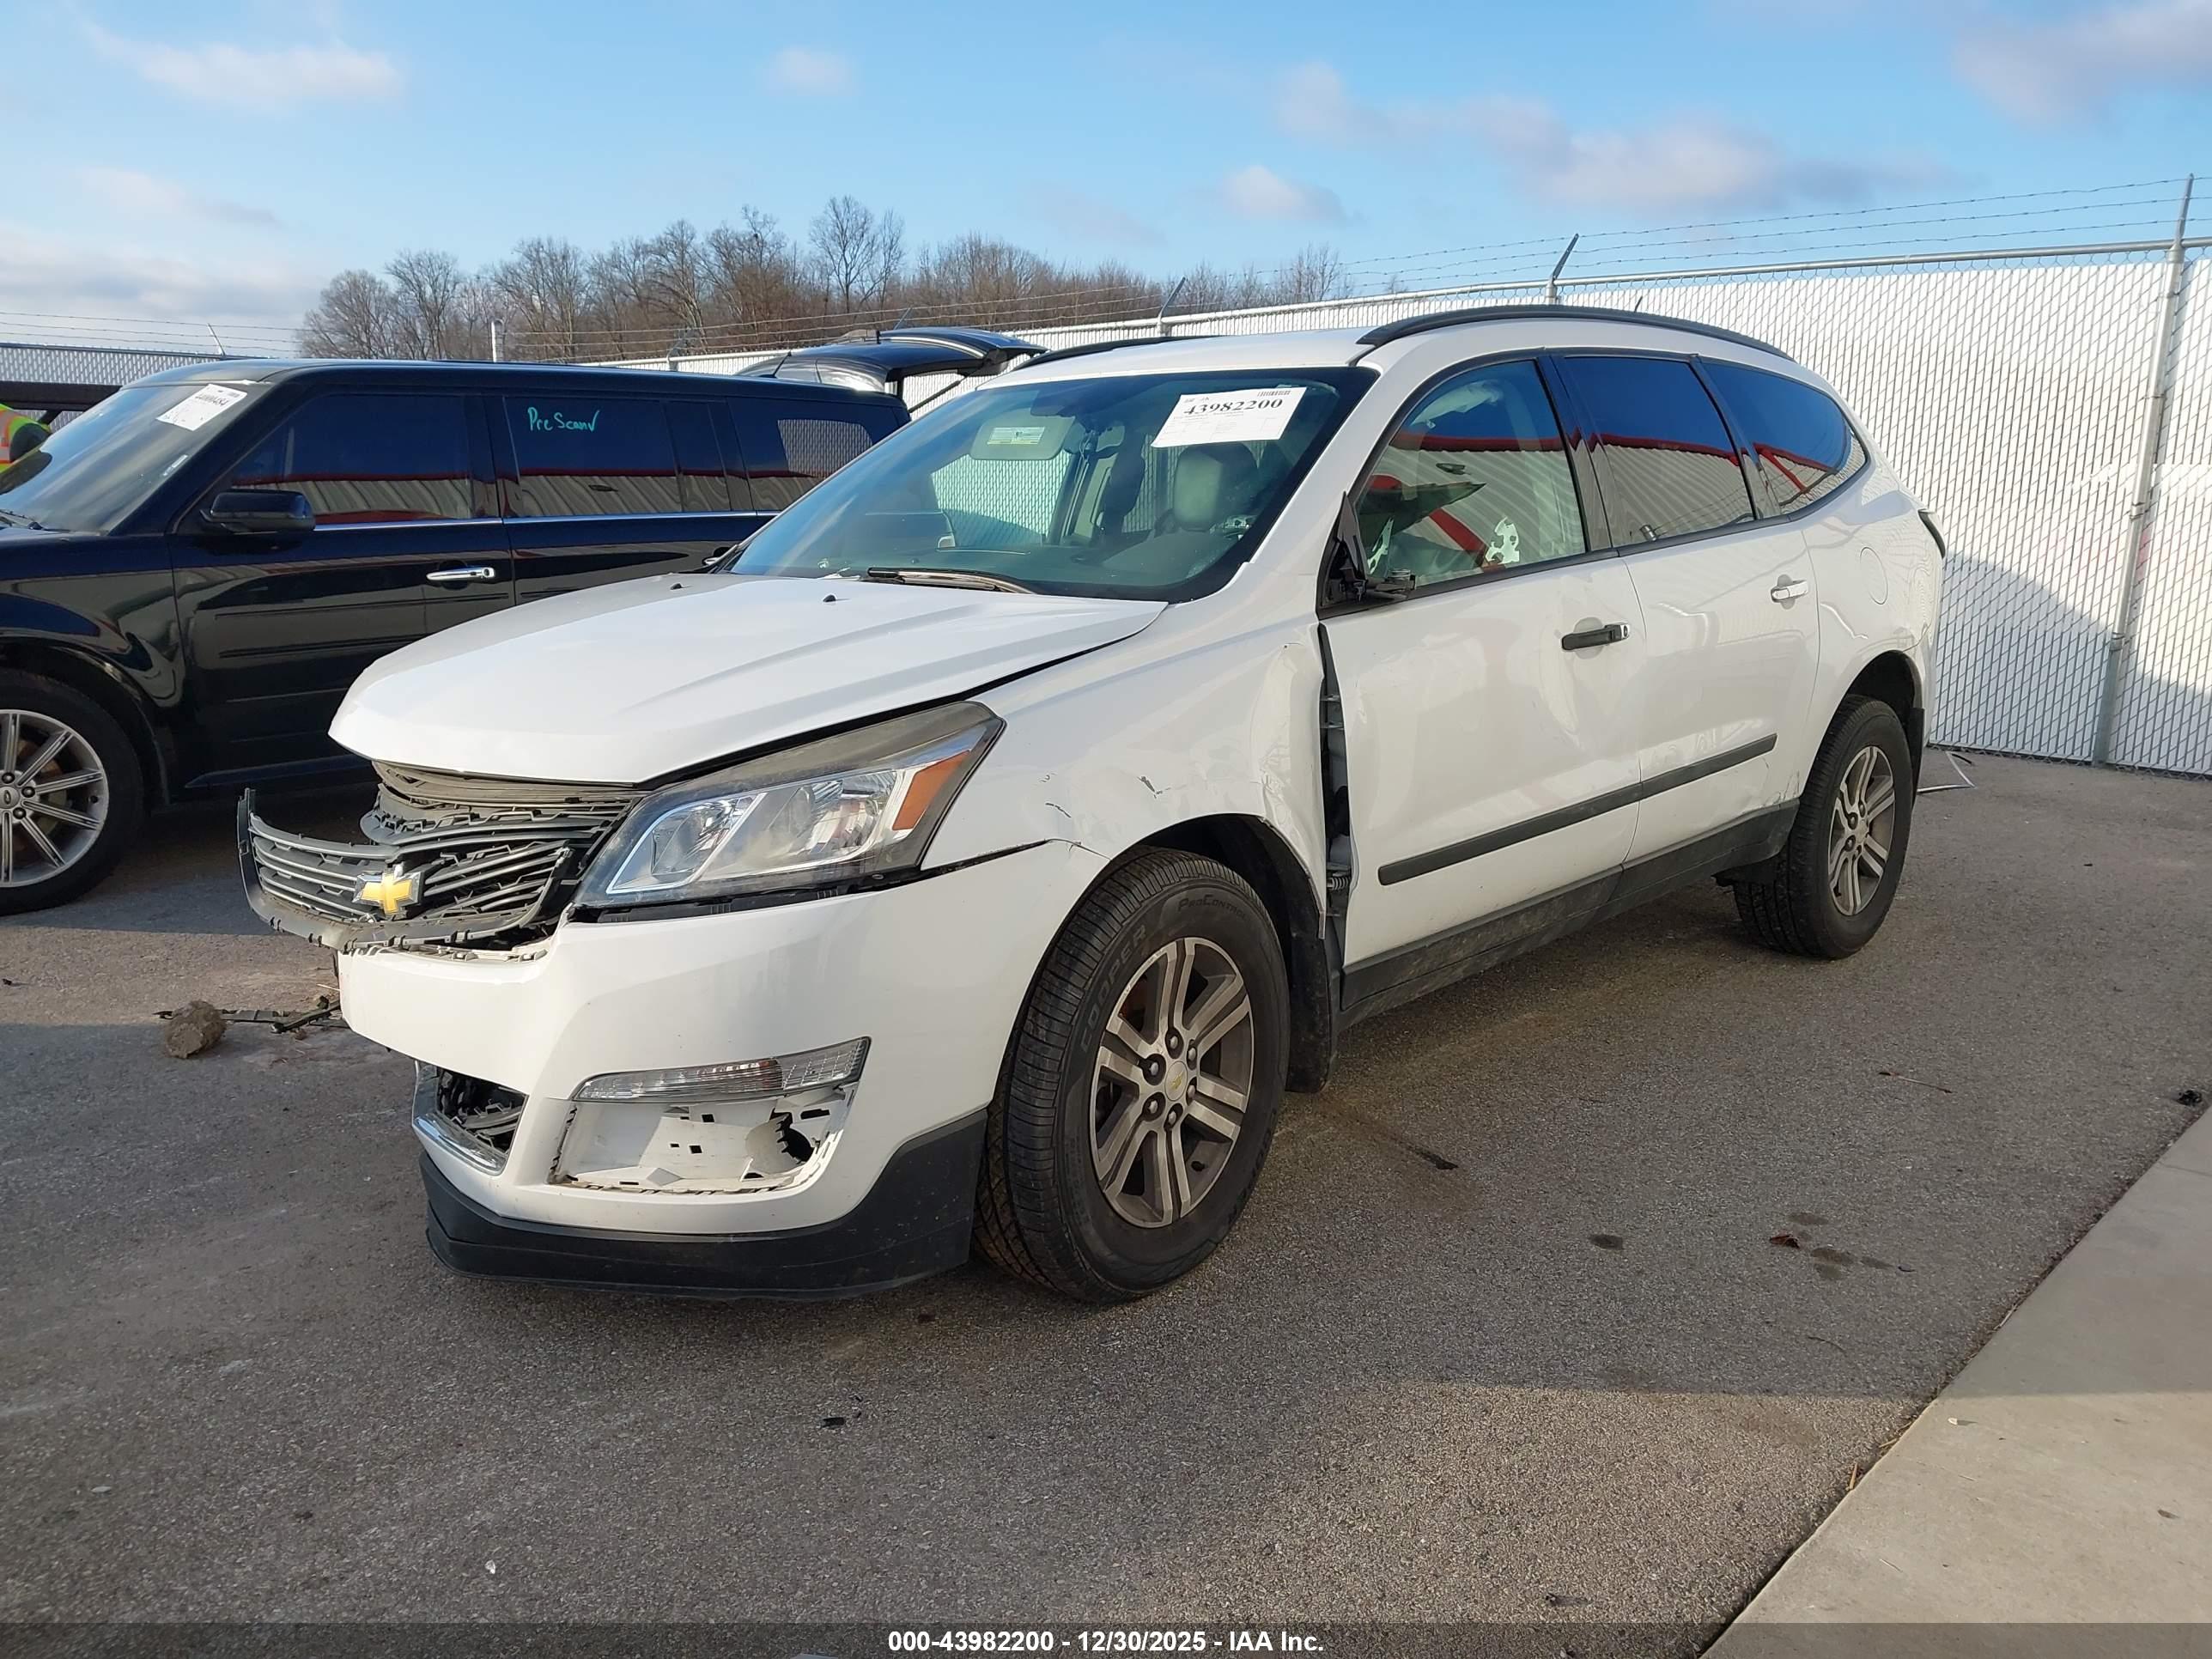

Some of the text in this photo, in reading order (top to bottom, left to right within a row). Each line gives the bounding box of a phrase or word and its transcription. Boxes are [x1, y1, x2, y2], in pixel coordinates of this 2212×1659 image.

[527, 407, 553, 431] Pre
[1184, 398, 1283, 416] 43982200
[1079, 923, 1147, 1053] COOPER
